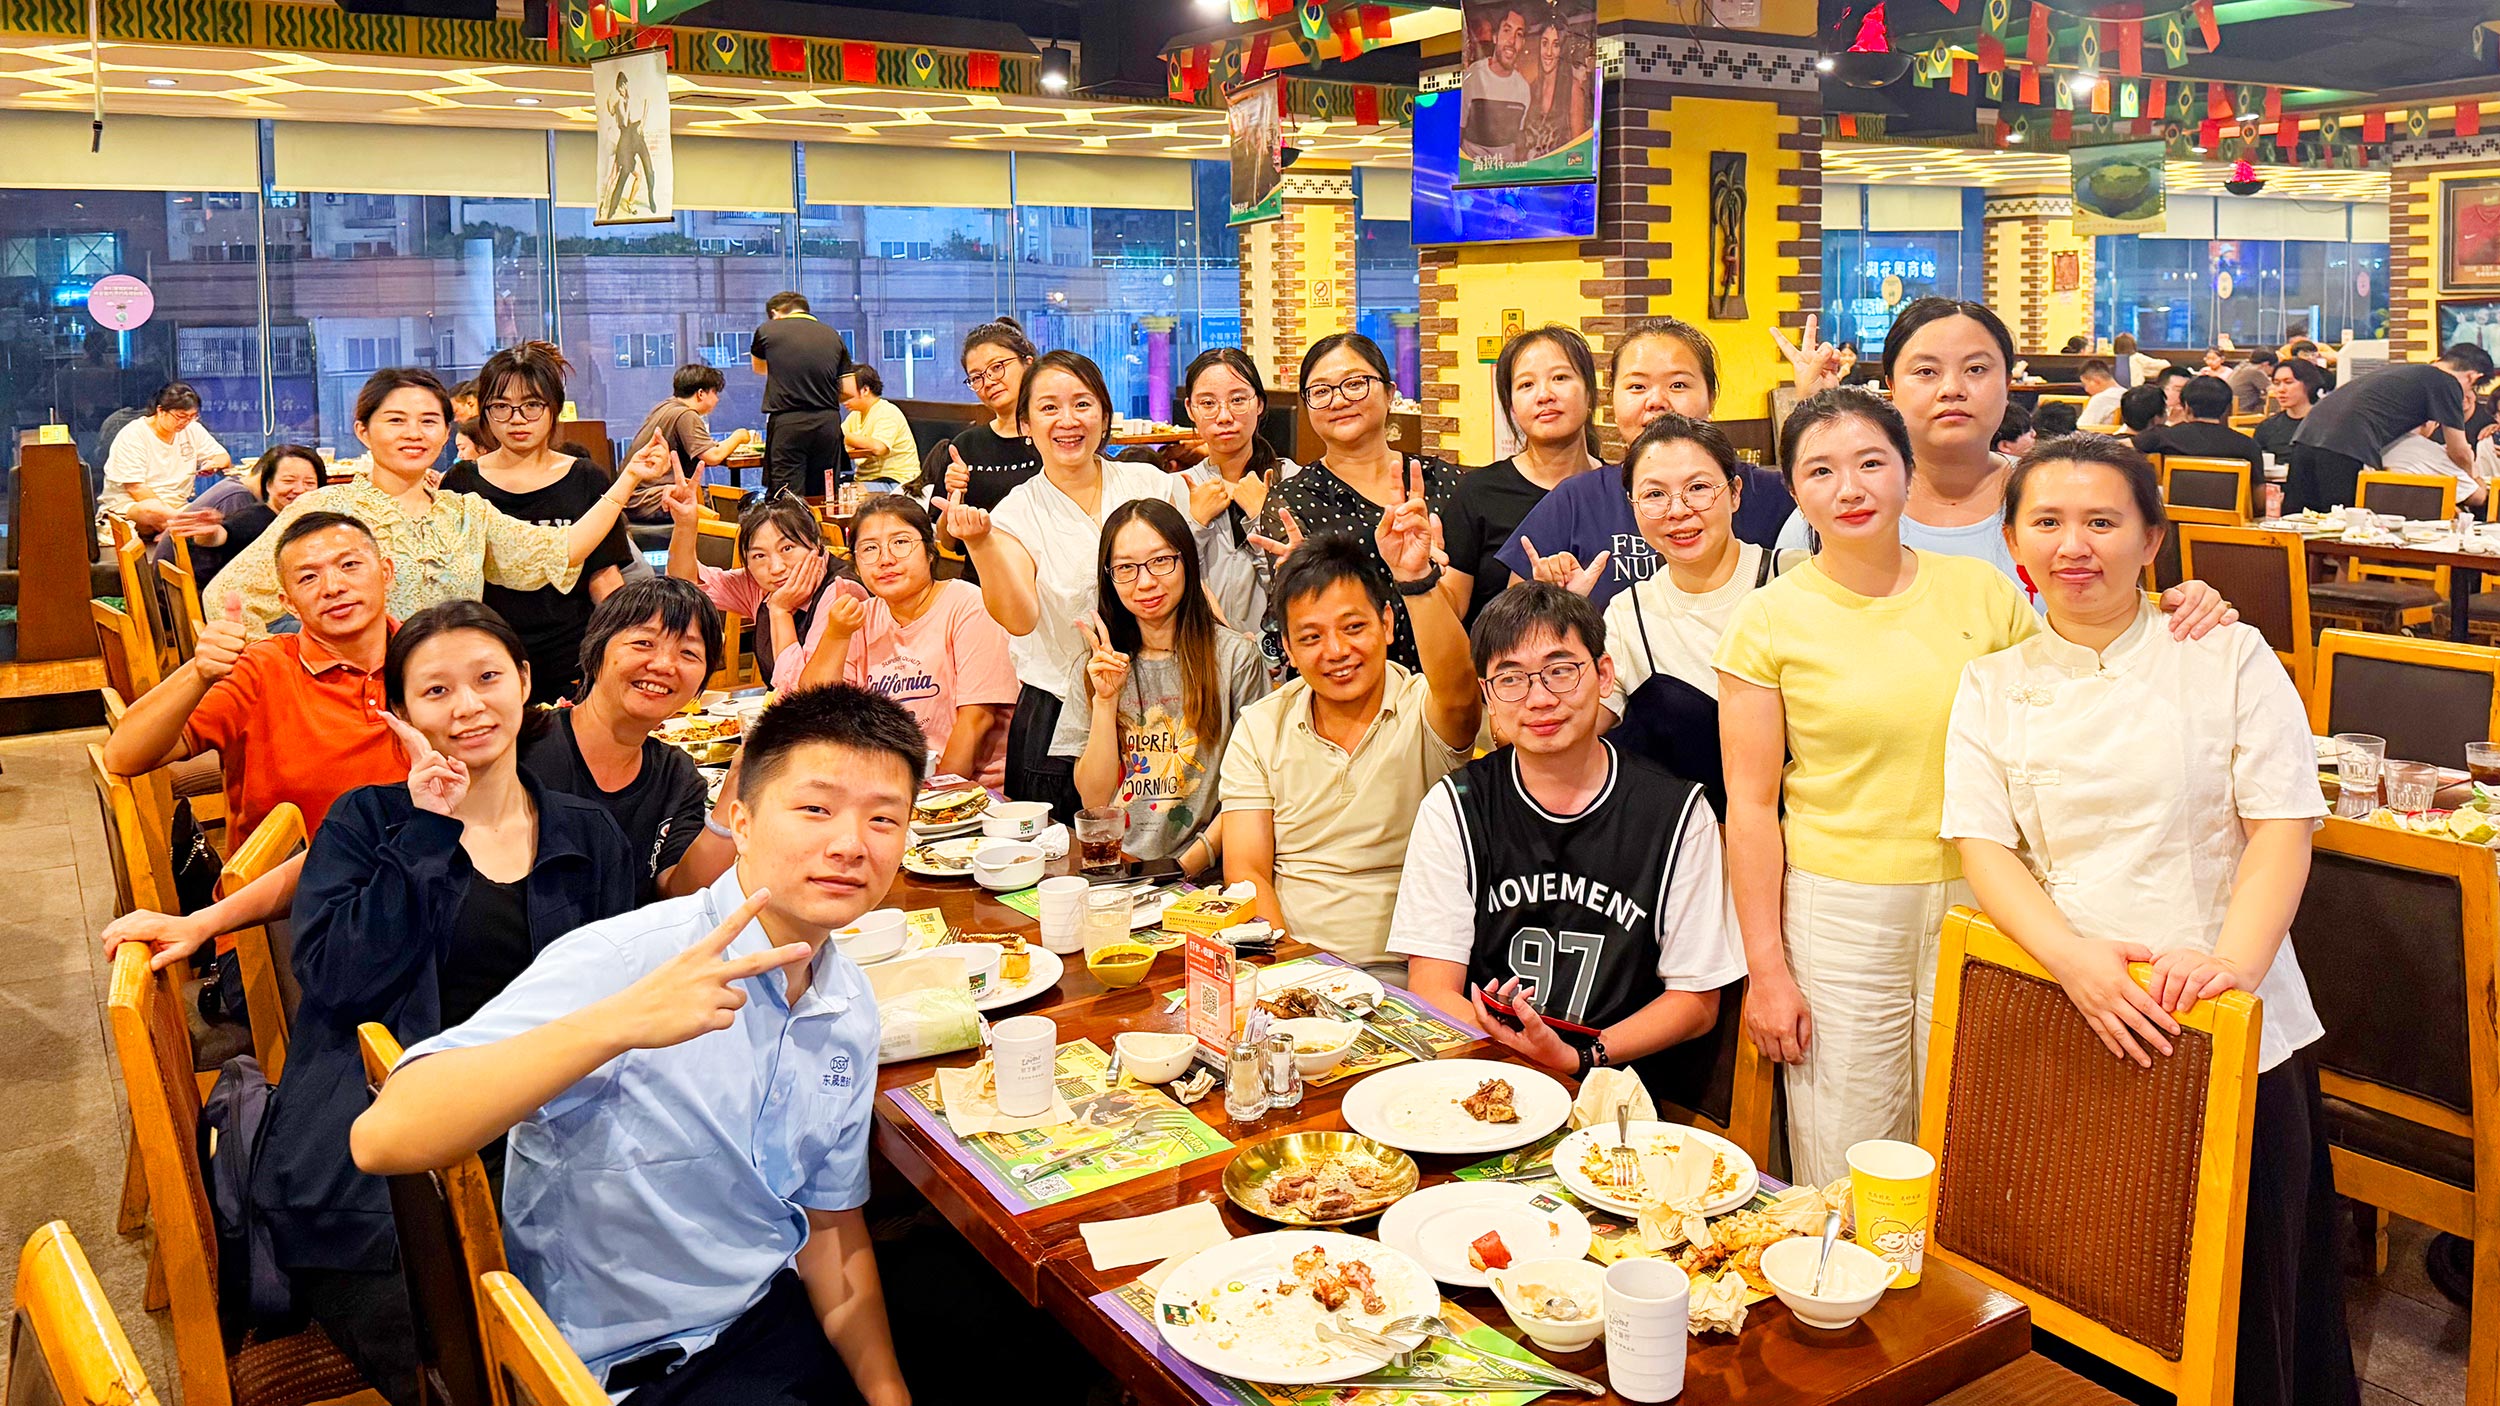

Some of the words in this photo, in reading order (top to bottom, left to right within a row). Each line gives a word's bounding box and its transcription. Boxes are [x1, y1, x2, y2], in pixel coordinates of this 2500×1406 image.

[1472, 153, 1505, 171] 高拉特
[867, 669, 940, 702] California
[1488, 872, 1648, 932] MOVEMENT
[1508, 926, 1605, 1025] 97
